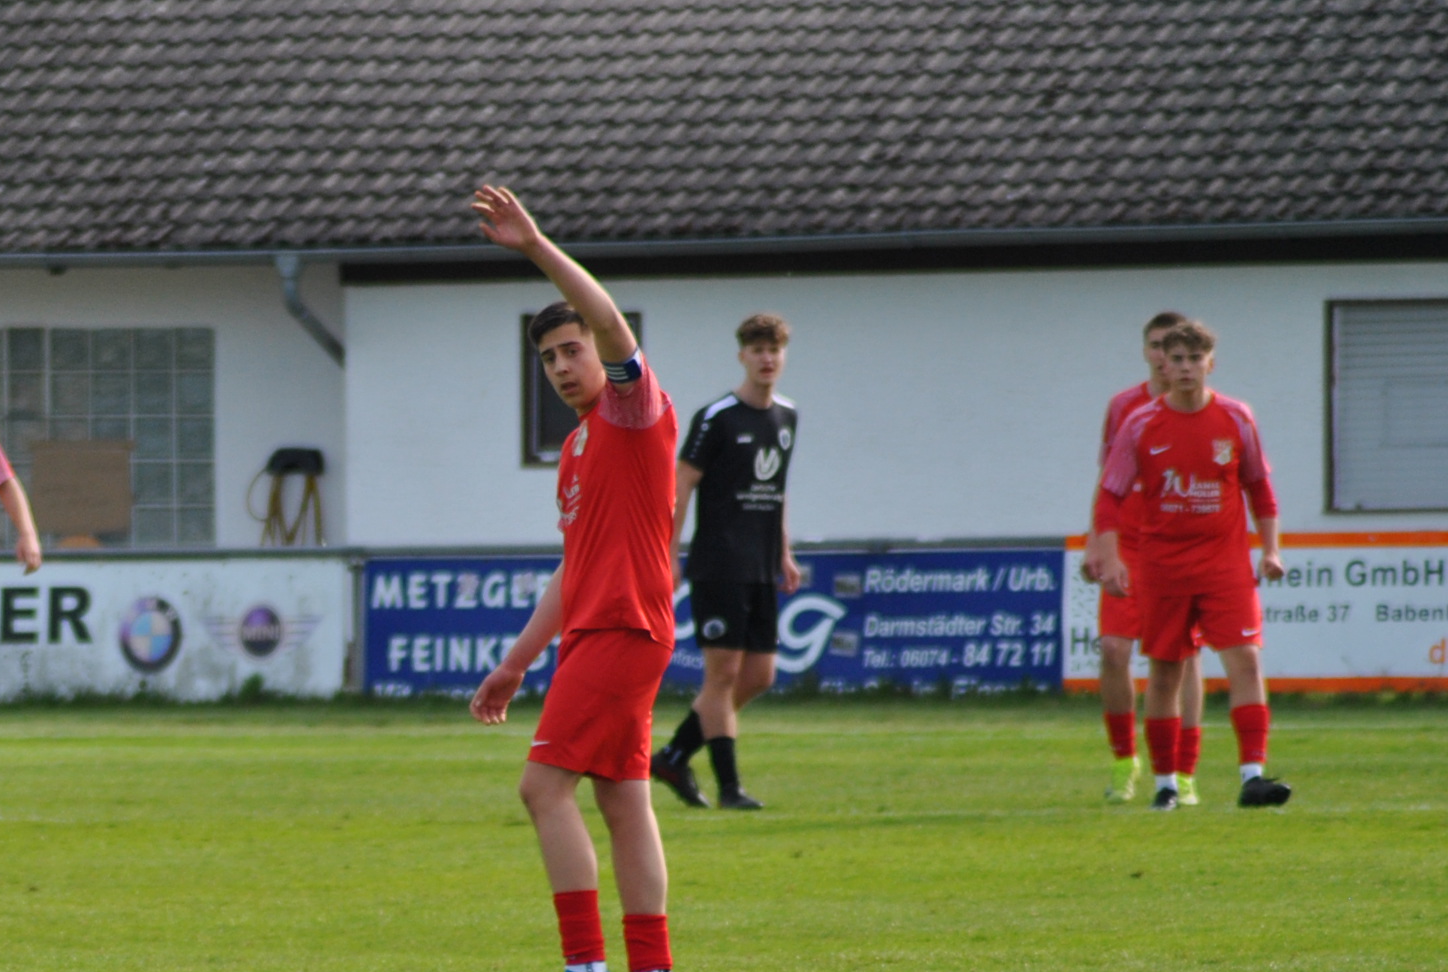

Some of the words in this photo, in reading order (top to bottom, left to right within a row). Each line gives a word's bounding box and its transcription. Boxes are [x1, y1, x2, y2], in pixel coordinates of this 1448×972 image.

[864, 565, 990, 592] Rödermark
[1007, 566, 1056, 592] Urb.
[1344, 559, 1445, 587] GmbH
[863, 614, 985, 638] Darmstädter
[990, 613, 1024, 637] Str.
[1029, 614, 1056, 636] 34
[1265, 604, 1320, 623] traße
[1326, 605, 1351, 623] 37
[899, 649, 948, 667] 06074
[962, 643, 991, 667] 84
[996, 643, 1024, 666] 72
[1031, 643, 1056, 666] 11
